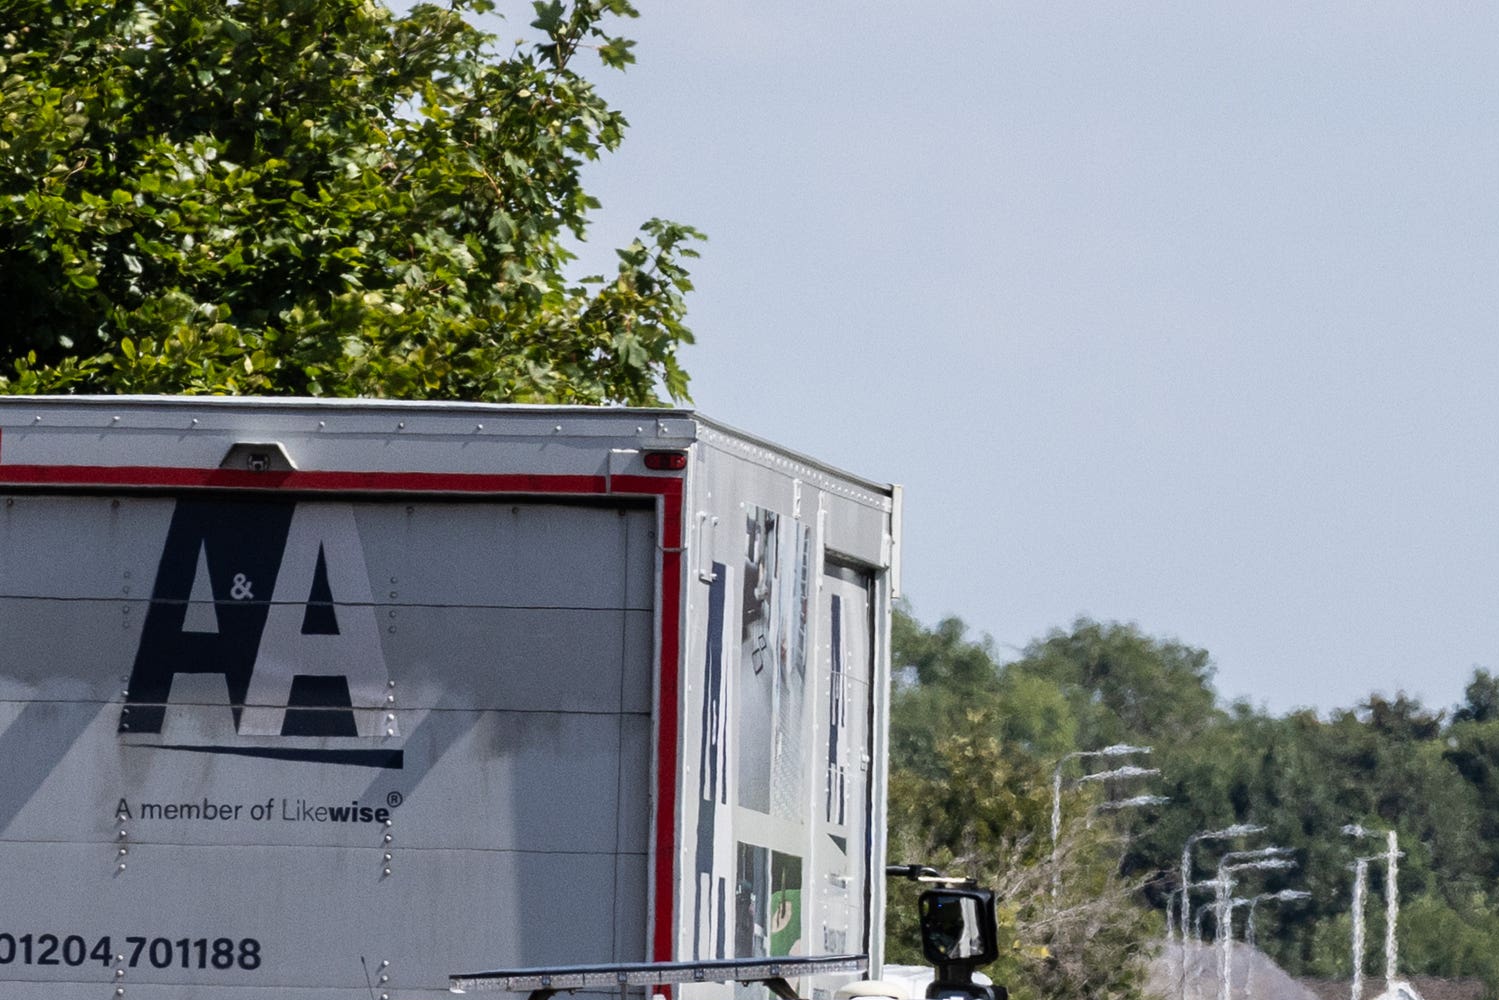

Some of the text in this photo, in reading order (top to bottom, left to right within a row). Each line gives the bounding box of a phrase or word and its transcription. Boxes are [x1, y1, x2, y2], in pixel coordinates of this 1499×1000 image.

[114, 798, 132, 820] A
[141, 799, 243, 821] member
[250, 798, 274, 821] of
[0, 933, 262, 970] 01204 701188
